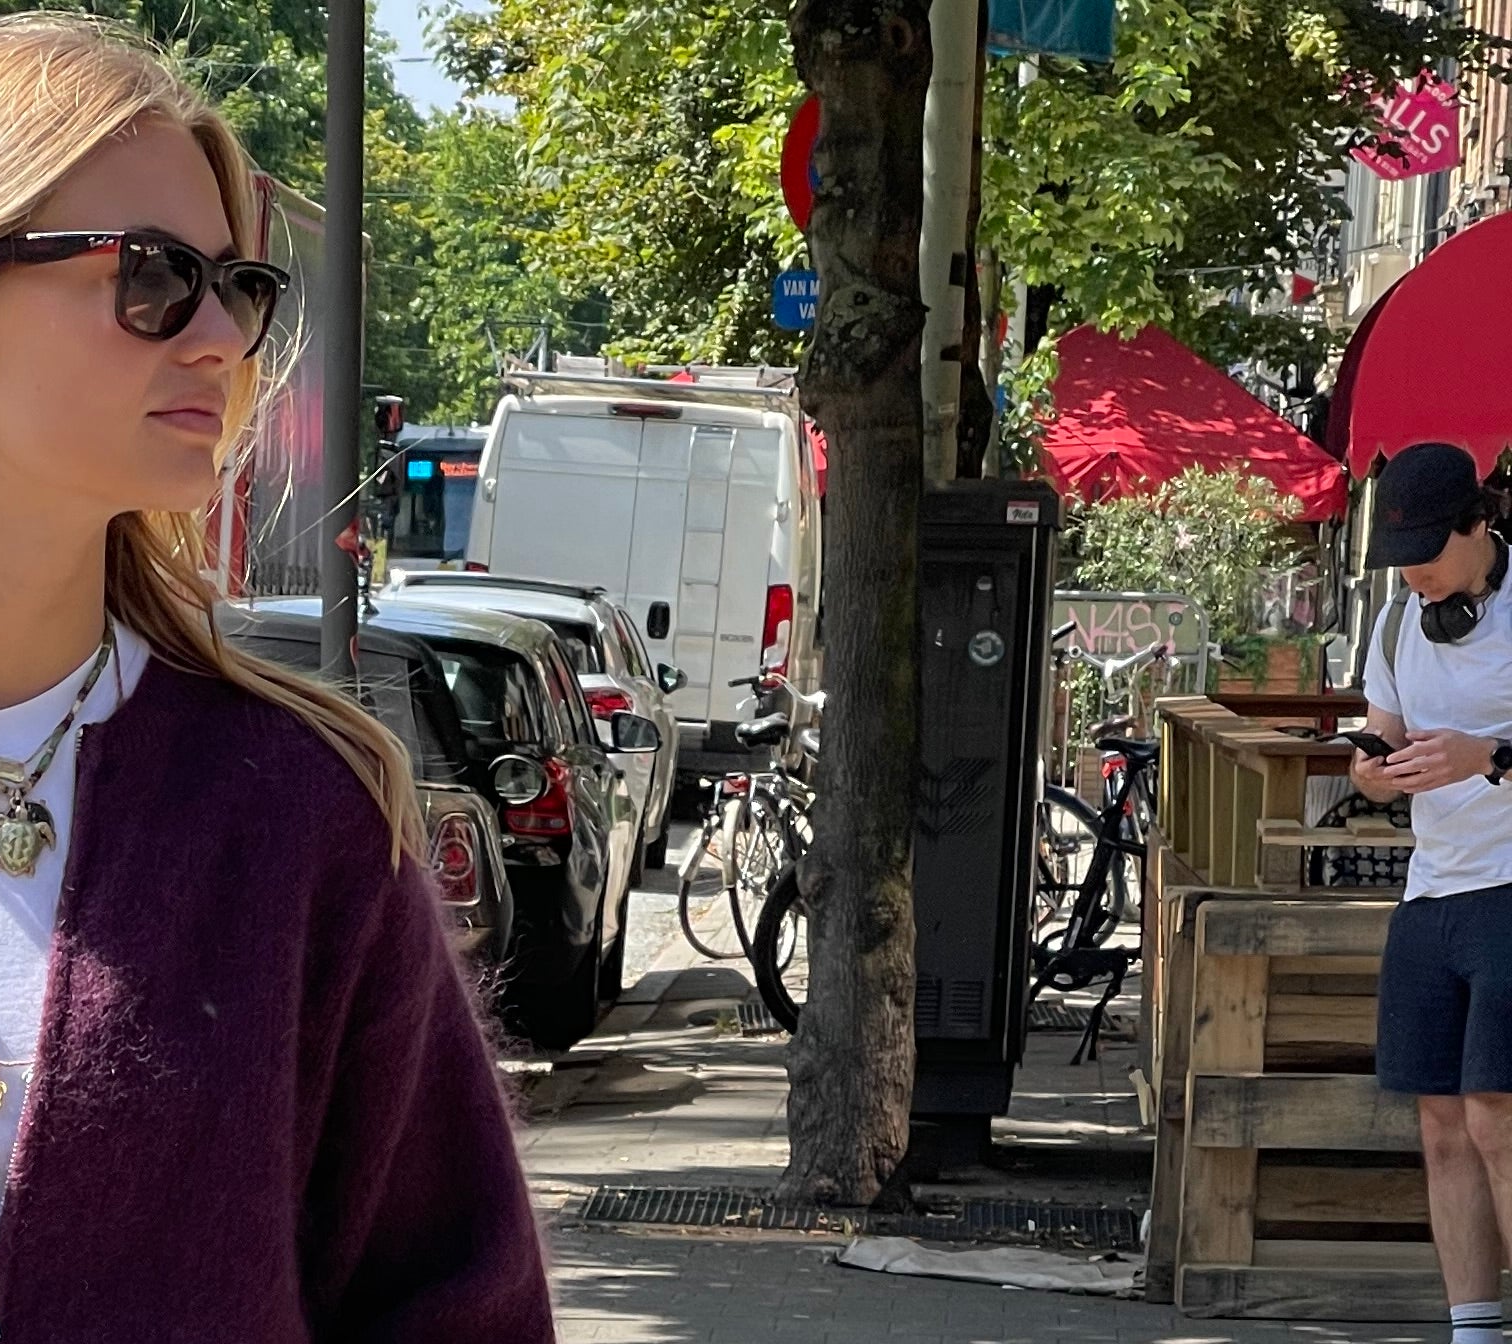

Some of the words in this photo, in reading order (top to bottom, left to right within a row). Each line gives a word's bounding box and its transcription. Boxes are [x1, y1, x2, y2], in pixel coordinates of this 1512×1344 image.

[1370, 97, 1450, 155] ALLS
[782, 279, 807, 297] VAN
[809, 279, 821, 297] M
[798, 302, 816, 320] VA
